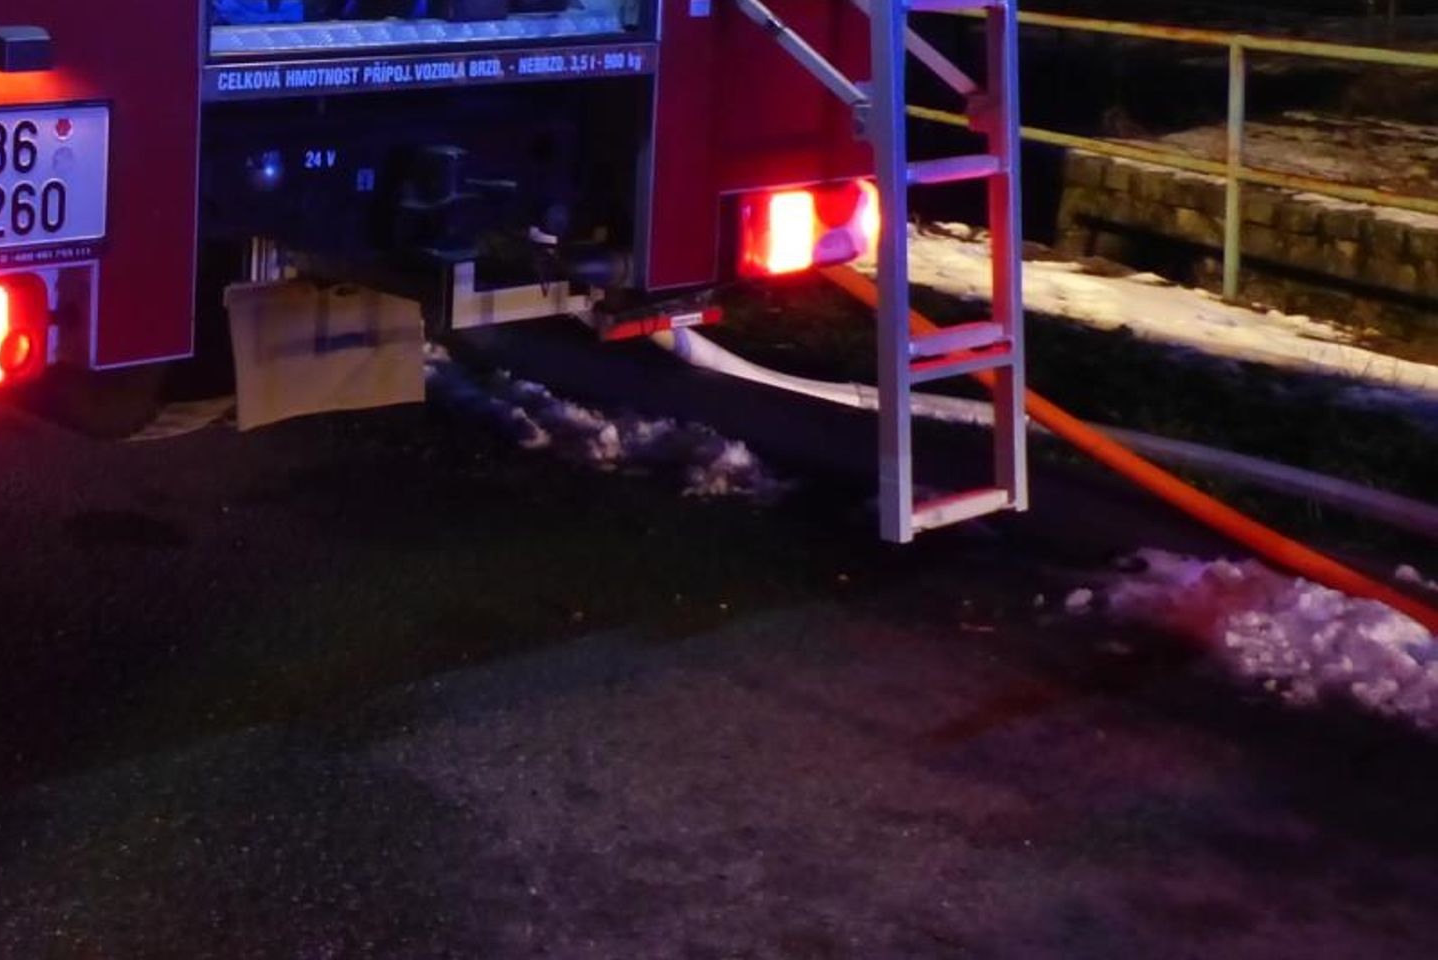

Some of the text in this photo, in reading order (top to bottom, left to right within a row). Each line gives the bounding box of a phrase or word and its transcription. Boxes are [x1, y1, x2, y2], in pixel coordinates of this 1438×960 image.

[217, 65, 281, 91] CELKOVÁ
[284, 67, 360, 88] HMOTNOST
[414, 61, 465, 81] VOZIDLA
[627, 51, 642, 71] kg
[305, 149, 336, 168] 24 V
